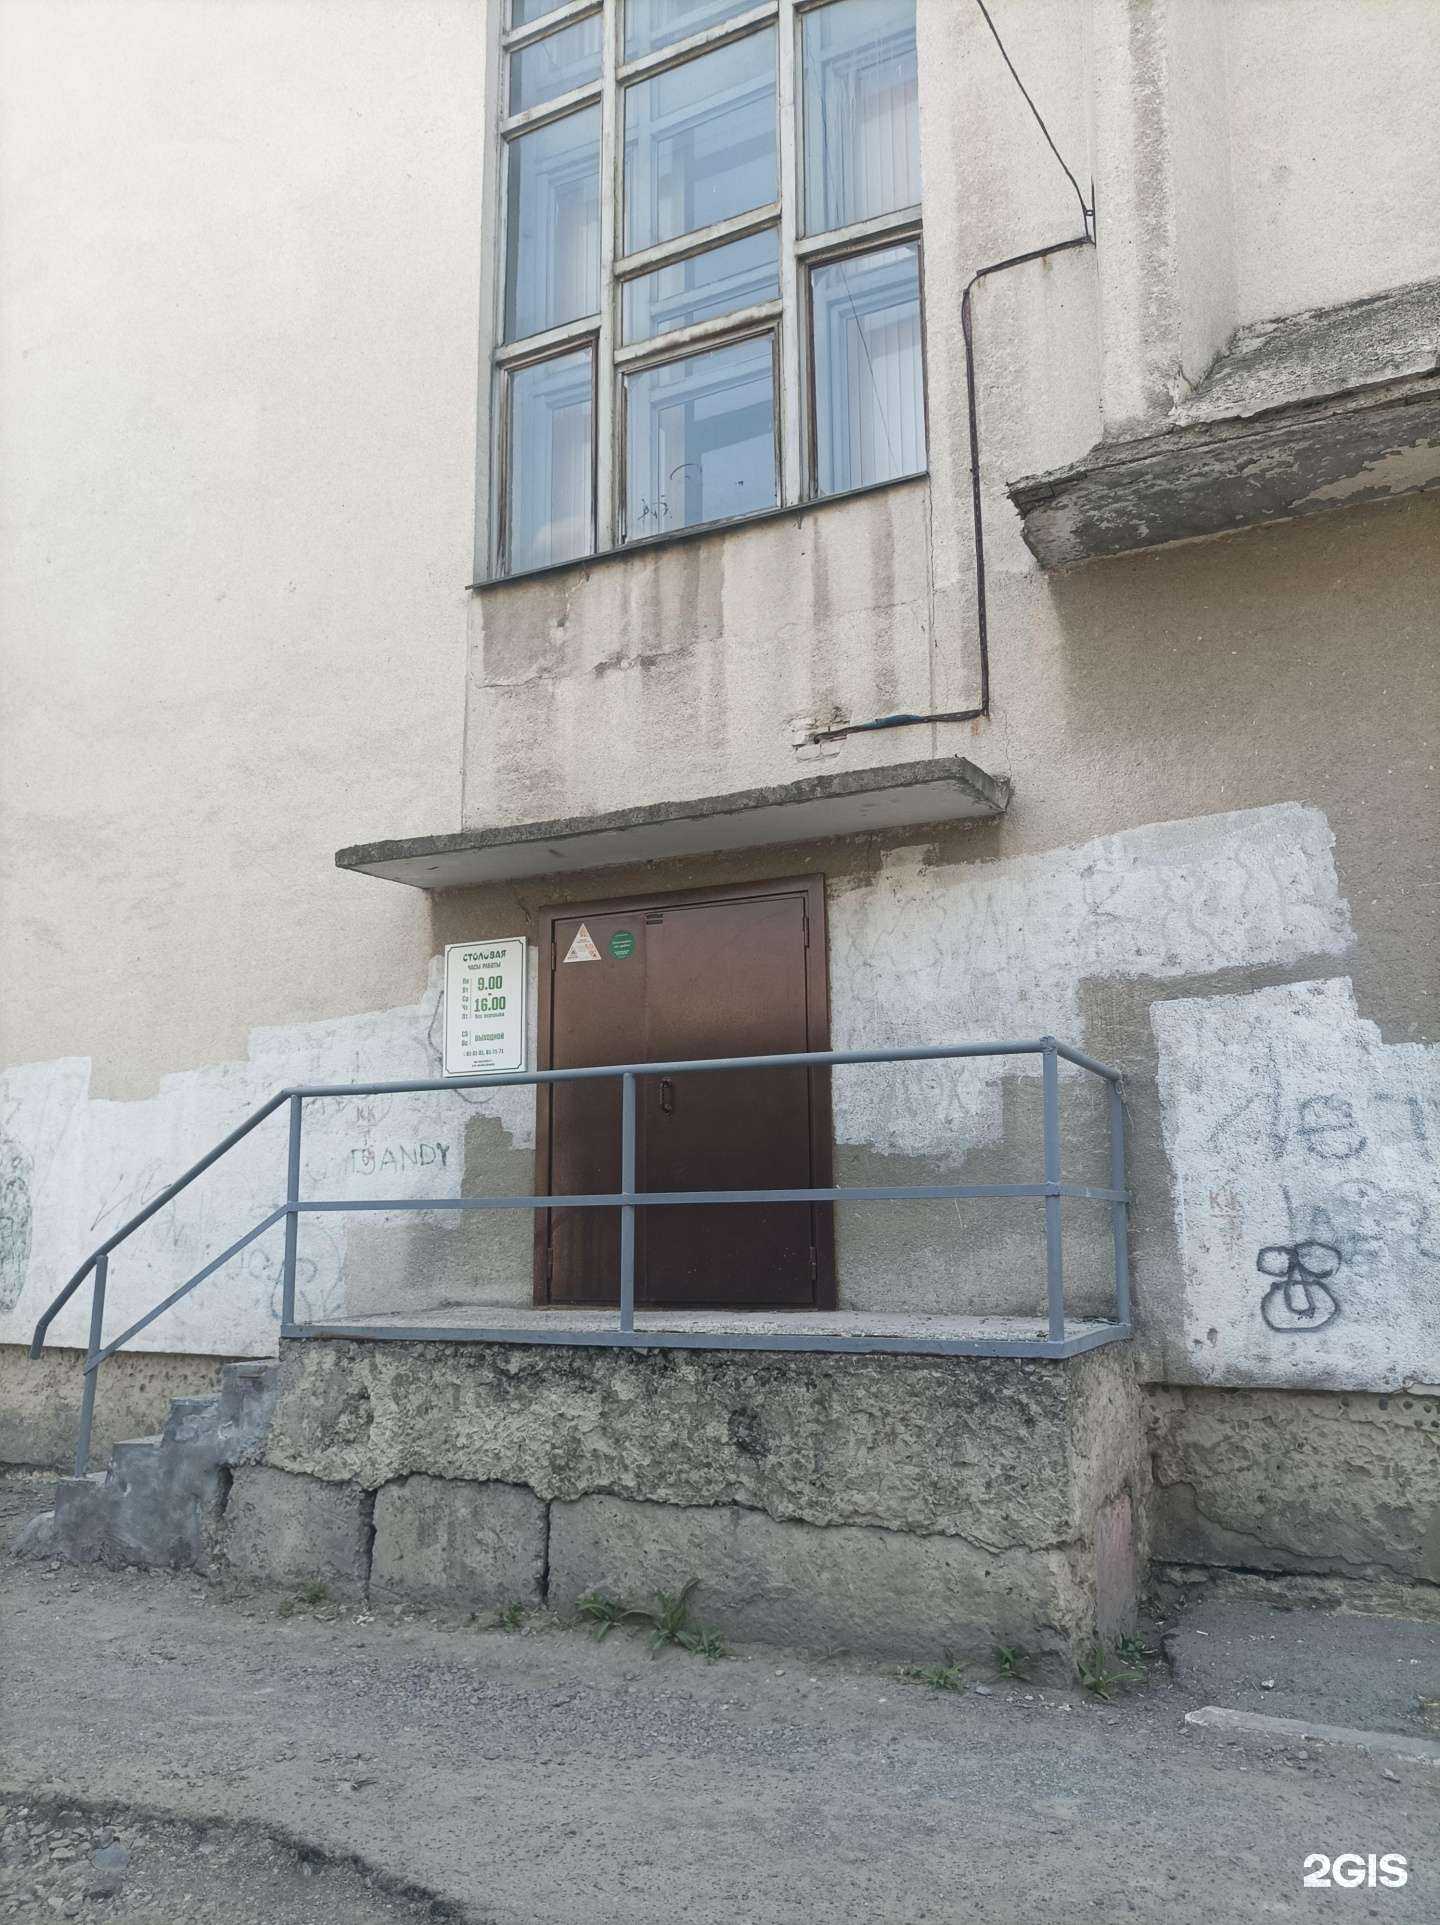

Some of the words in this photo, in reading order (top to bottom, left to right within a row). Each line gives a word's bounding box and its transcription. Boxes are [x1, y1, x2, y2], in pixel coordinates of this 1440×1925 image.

[463, 950, 506, 961] СТОЛОВАЯ
[478, 975, 502, 990] 9.00
[474, 996, 505, 1012] 16.00
